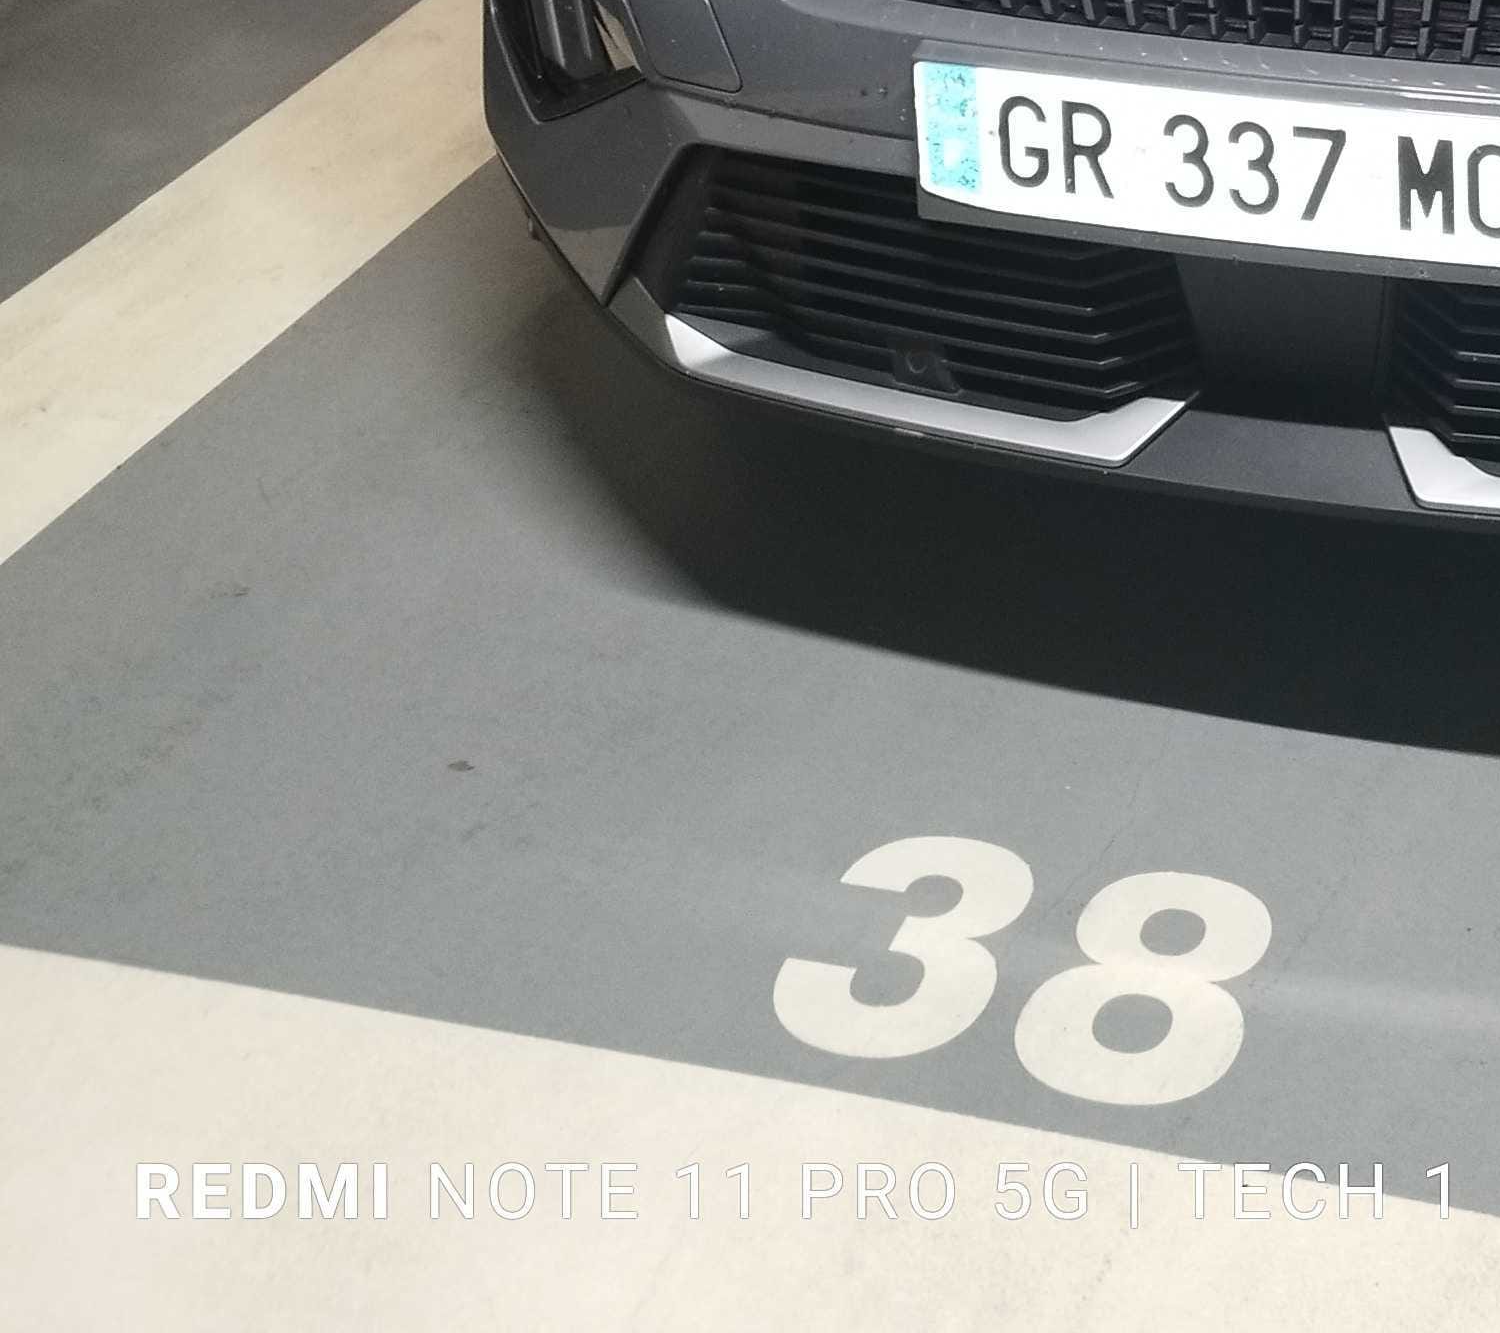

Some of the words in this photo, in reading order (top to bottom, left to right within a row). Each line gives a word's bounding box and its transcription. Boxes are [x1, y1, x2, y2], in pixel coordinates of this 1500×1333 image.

[998, 95, 1114, 199] GR
[1163, 114, 1347, 222] 337
[773, 835, 1272, 1105] 38
